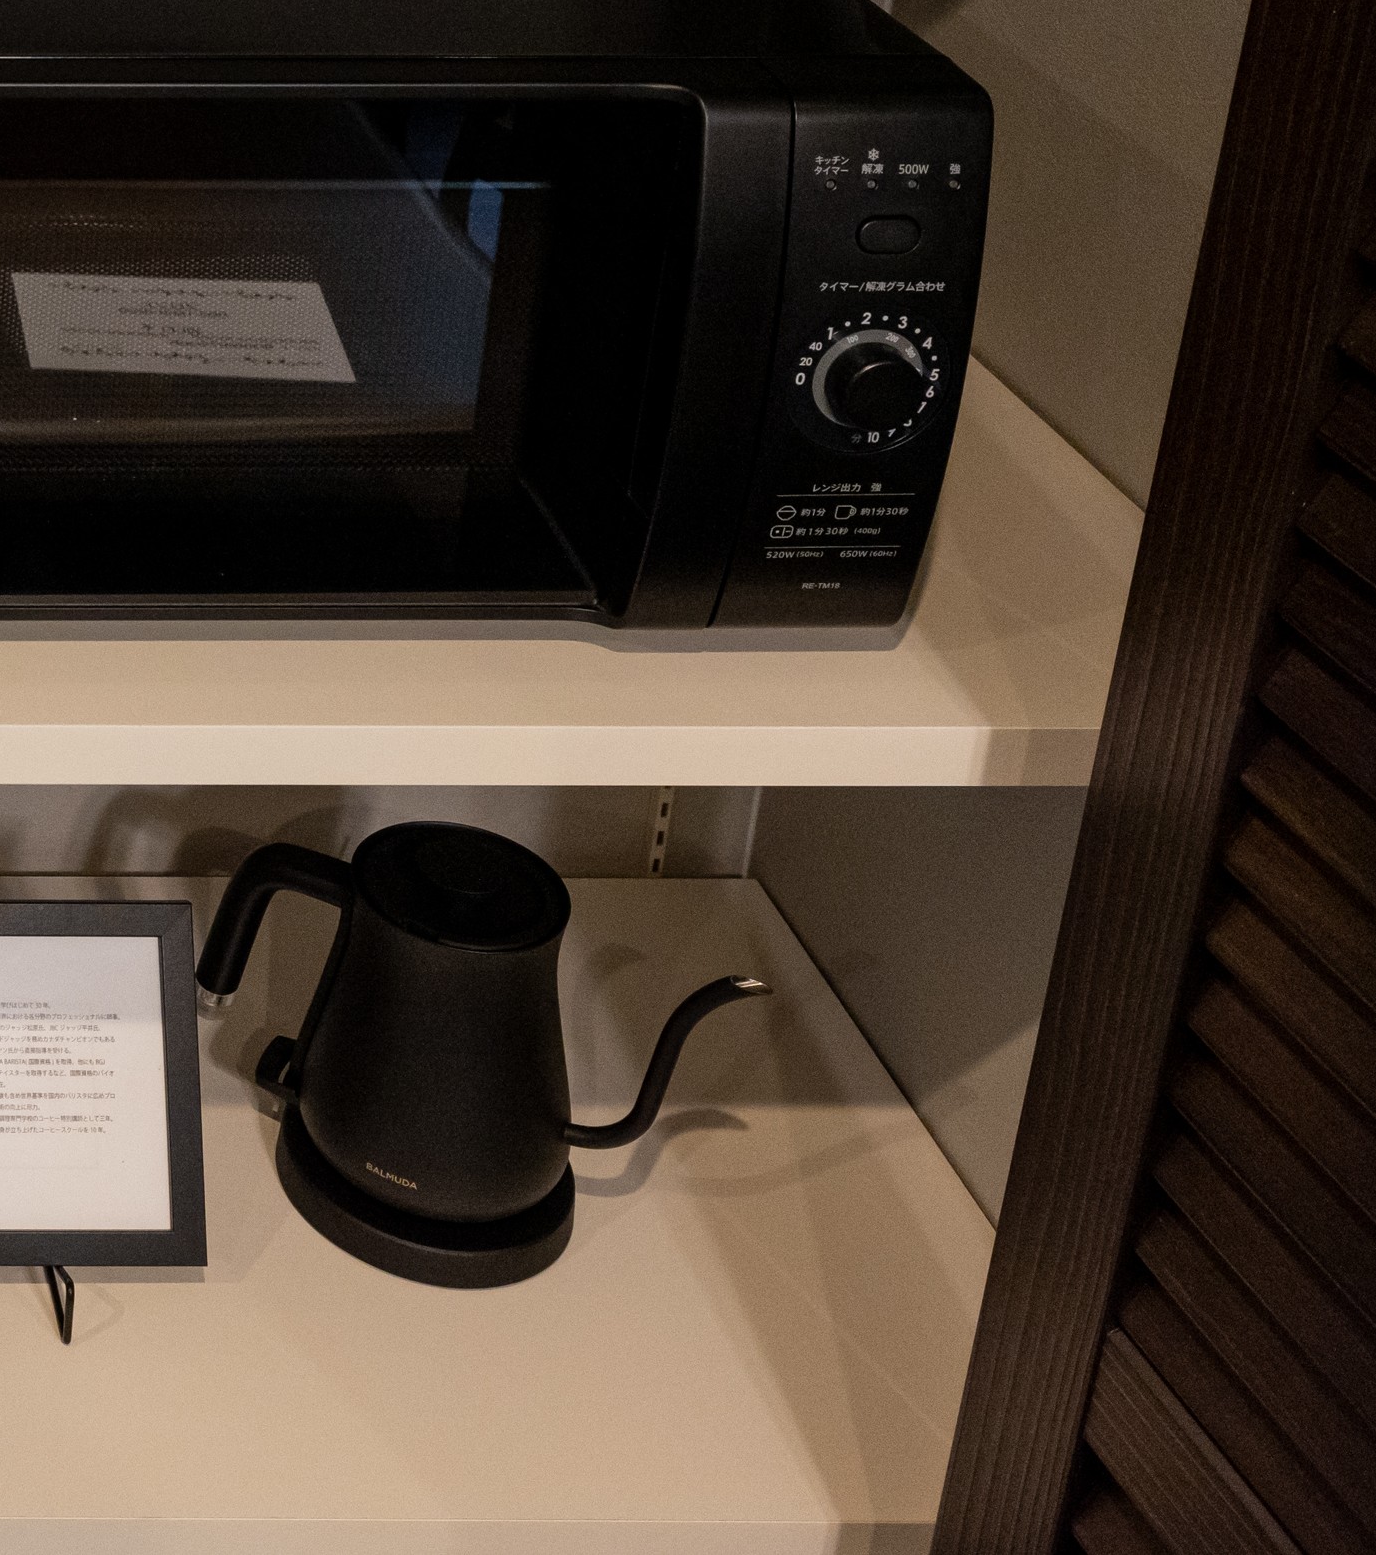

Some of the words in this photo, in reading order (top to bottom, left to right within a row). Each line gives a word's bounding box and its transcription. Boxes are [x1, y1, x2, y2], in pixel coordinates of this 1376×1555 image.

[814, 155, 850, 165] キッチン
[814, 166, 850, 175] タイマー
[861, 163, 884, 175] 解凍
[898, 163, 929, 175] 500W
[949, 163, 961, 175] 強
[819, 281, 946, 292] タイマー/解凍グラム合わせ
[860, 312, 872, 326] 2
[897, 315, 909, 329] 3
[846, 334, 859, 344] 100
[886, 331, 900, 343] 200
[922, 336, 933, 350] 4
[809, 341, 823, 351] 40
[799, 357, 814, 367] 20
[794, 372, 807, 386] 0
[929, 368, 941, 382] 5
[925, 385, 936, 399] 6
[867, 431, 881, 444] 10
[812, 483, 861, 493] レンジ出力
[869, 482, 882, 492] 強
[800, 508, 826, 517] 約1分
[860, 507, 909, 516] 約1分30秒
[854, 527, 881, 536] (400g)
[366, 1162, 418, 1191] BALMUDA
